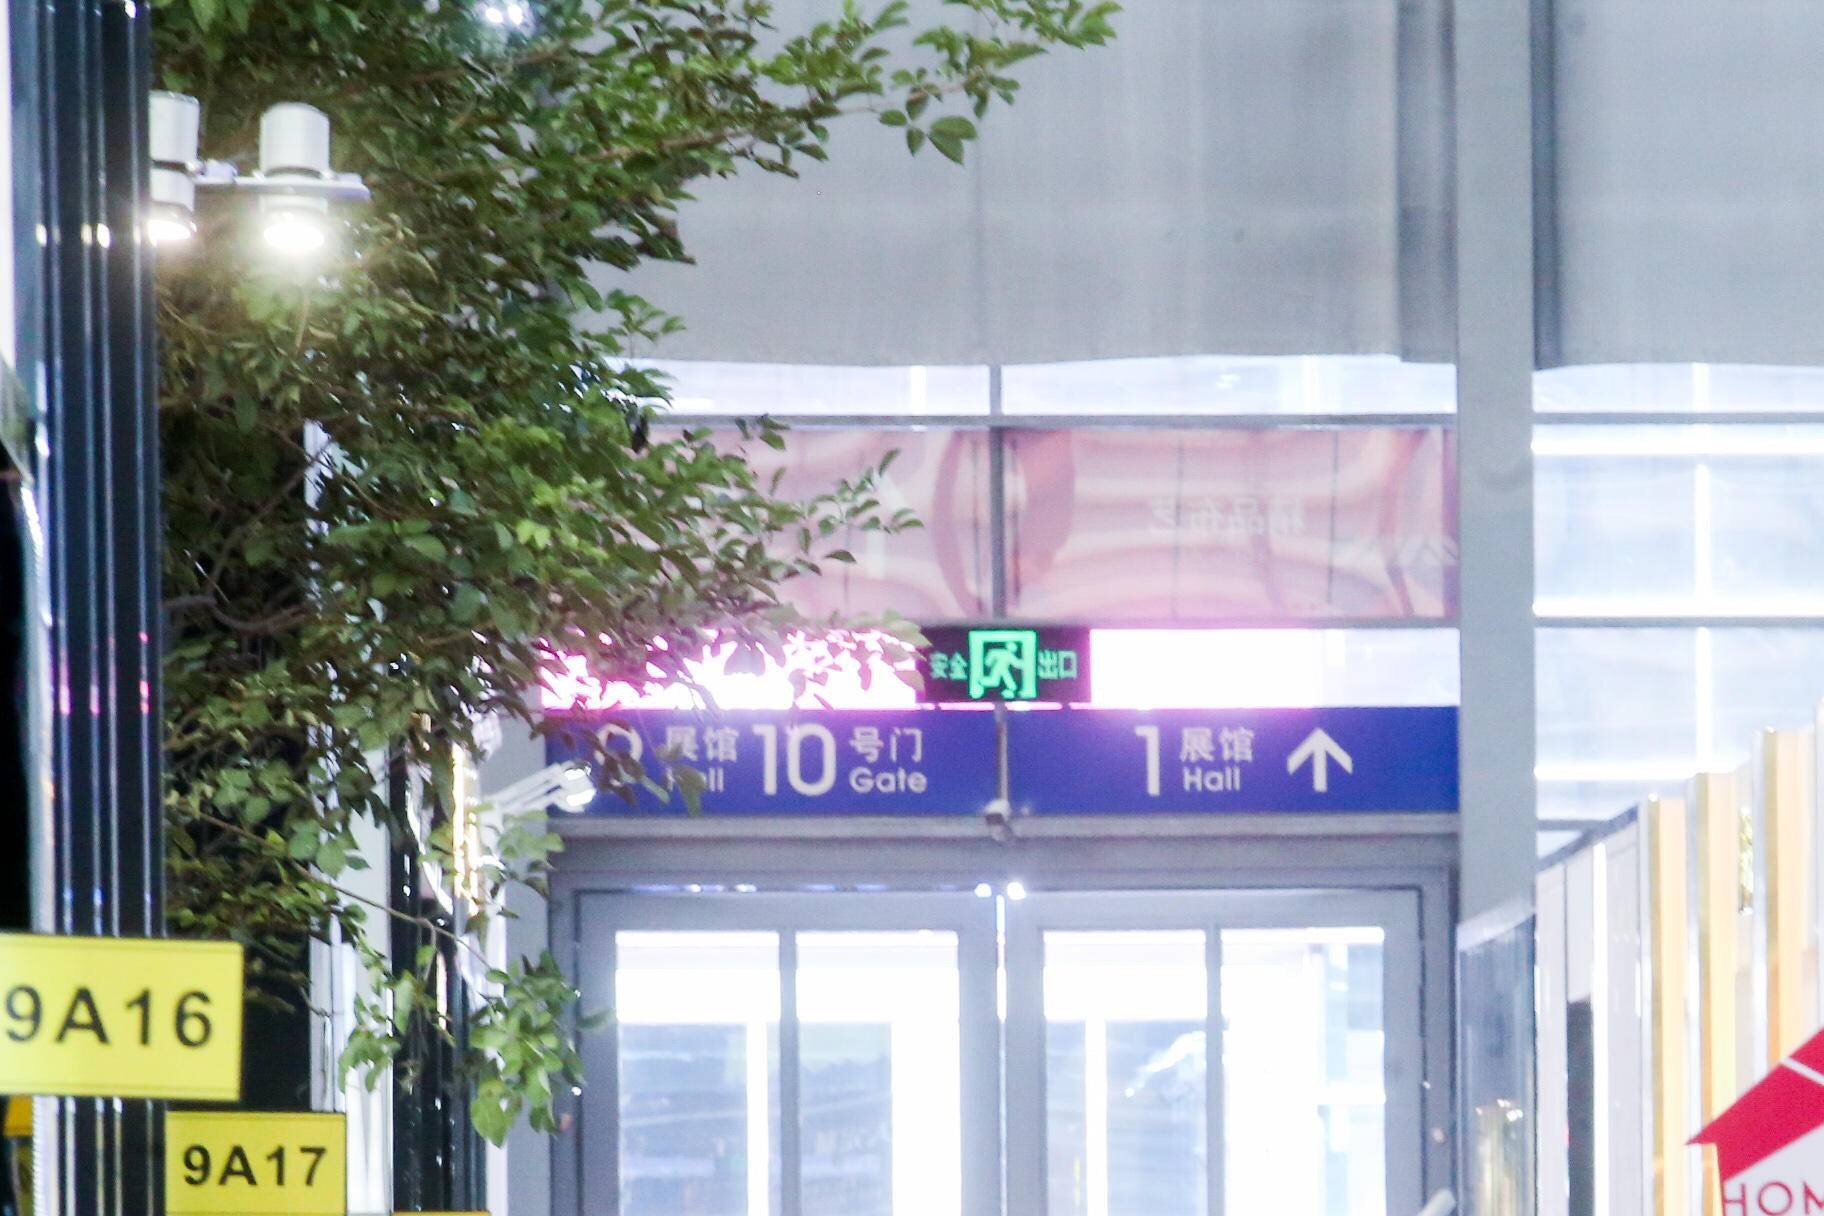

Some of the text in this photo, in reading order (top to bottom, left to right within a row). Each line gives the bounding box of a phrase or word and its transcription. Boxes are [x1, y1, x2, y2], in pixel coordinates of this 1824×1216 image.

[930, 651, 1078, 680] 安全 出口
[665, 725, 739, 763] 展馆
[752, 723, 837, 796] 10
[849, 726, 924, 763] 号门
[849, 766, 928, 794] Gate
[1134, 725, 1256, 796] 1 展馆
[1182, 766, 1241, 792] Hall
[5, 984, 213, 1049] 9A16
[182, 1144, 327, 1187] 9A17
